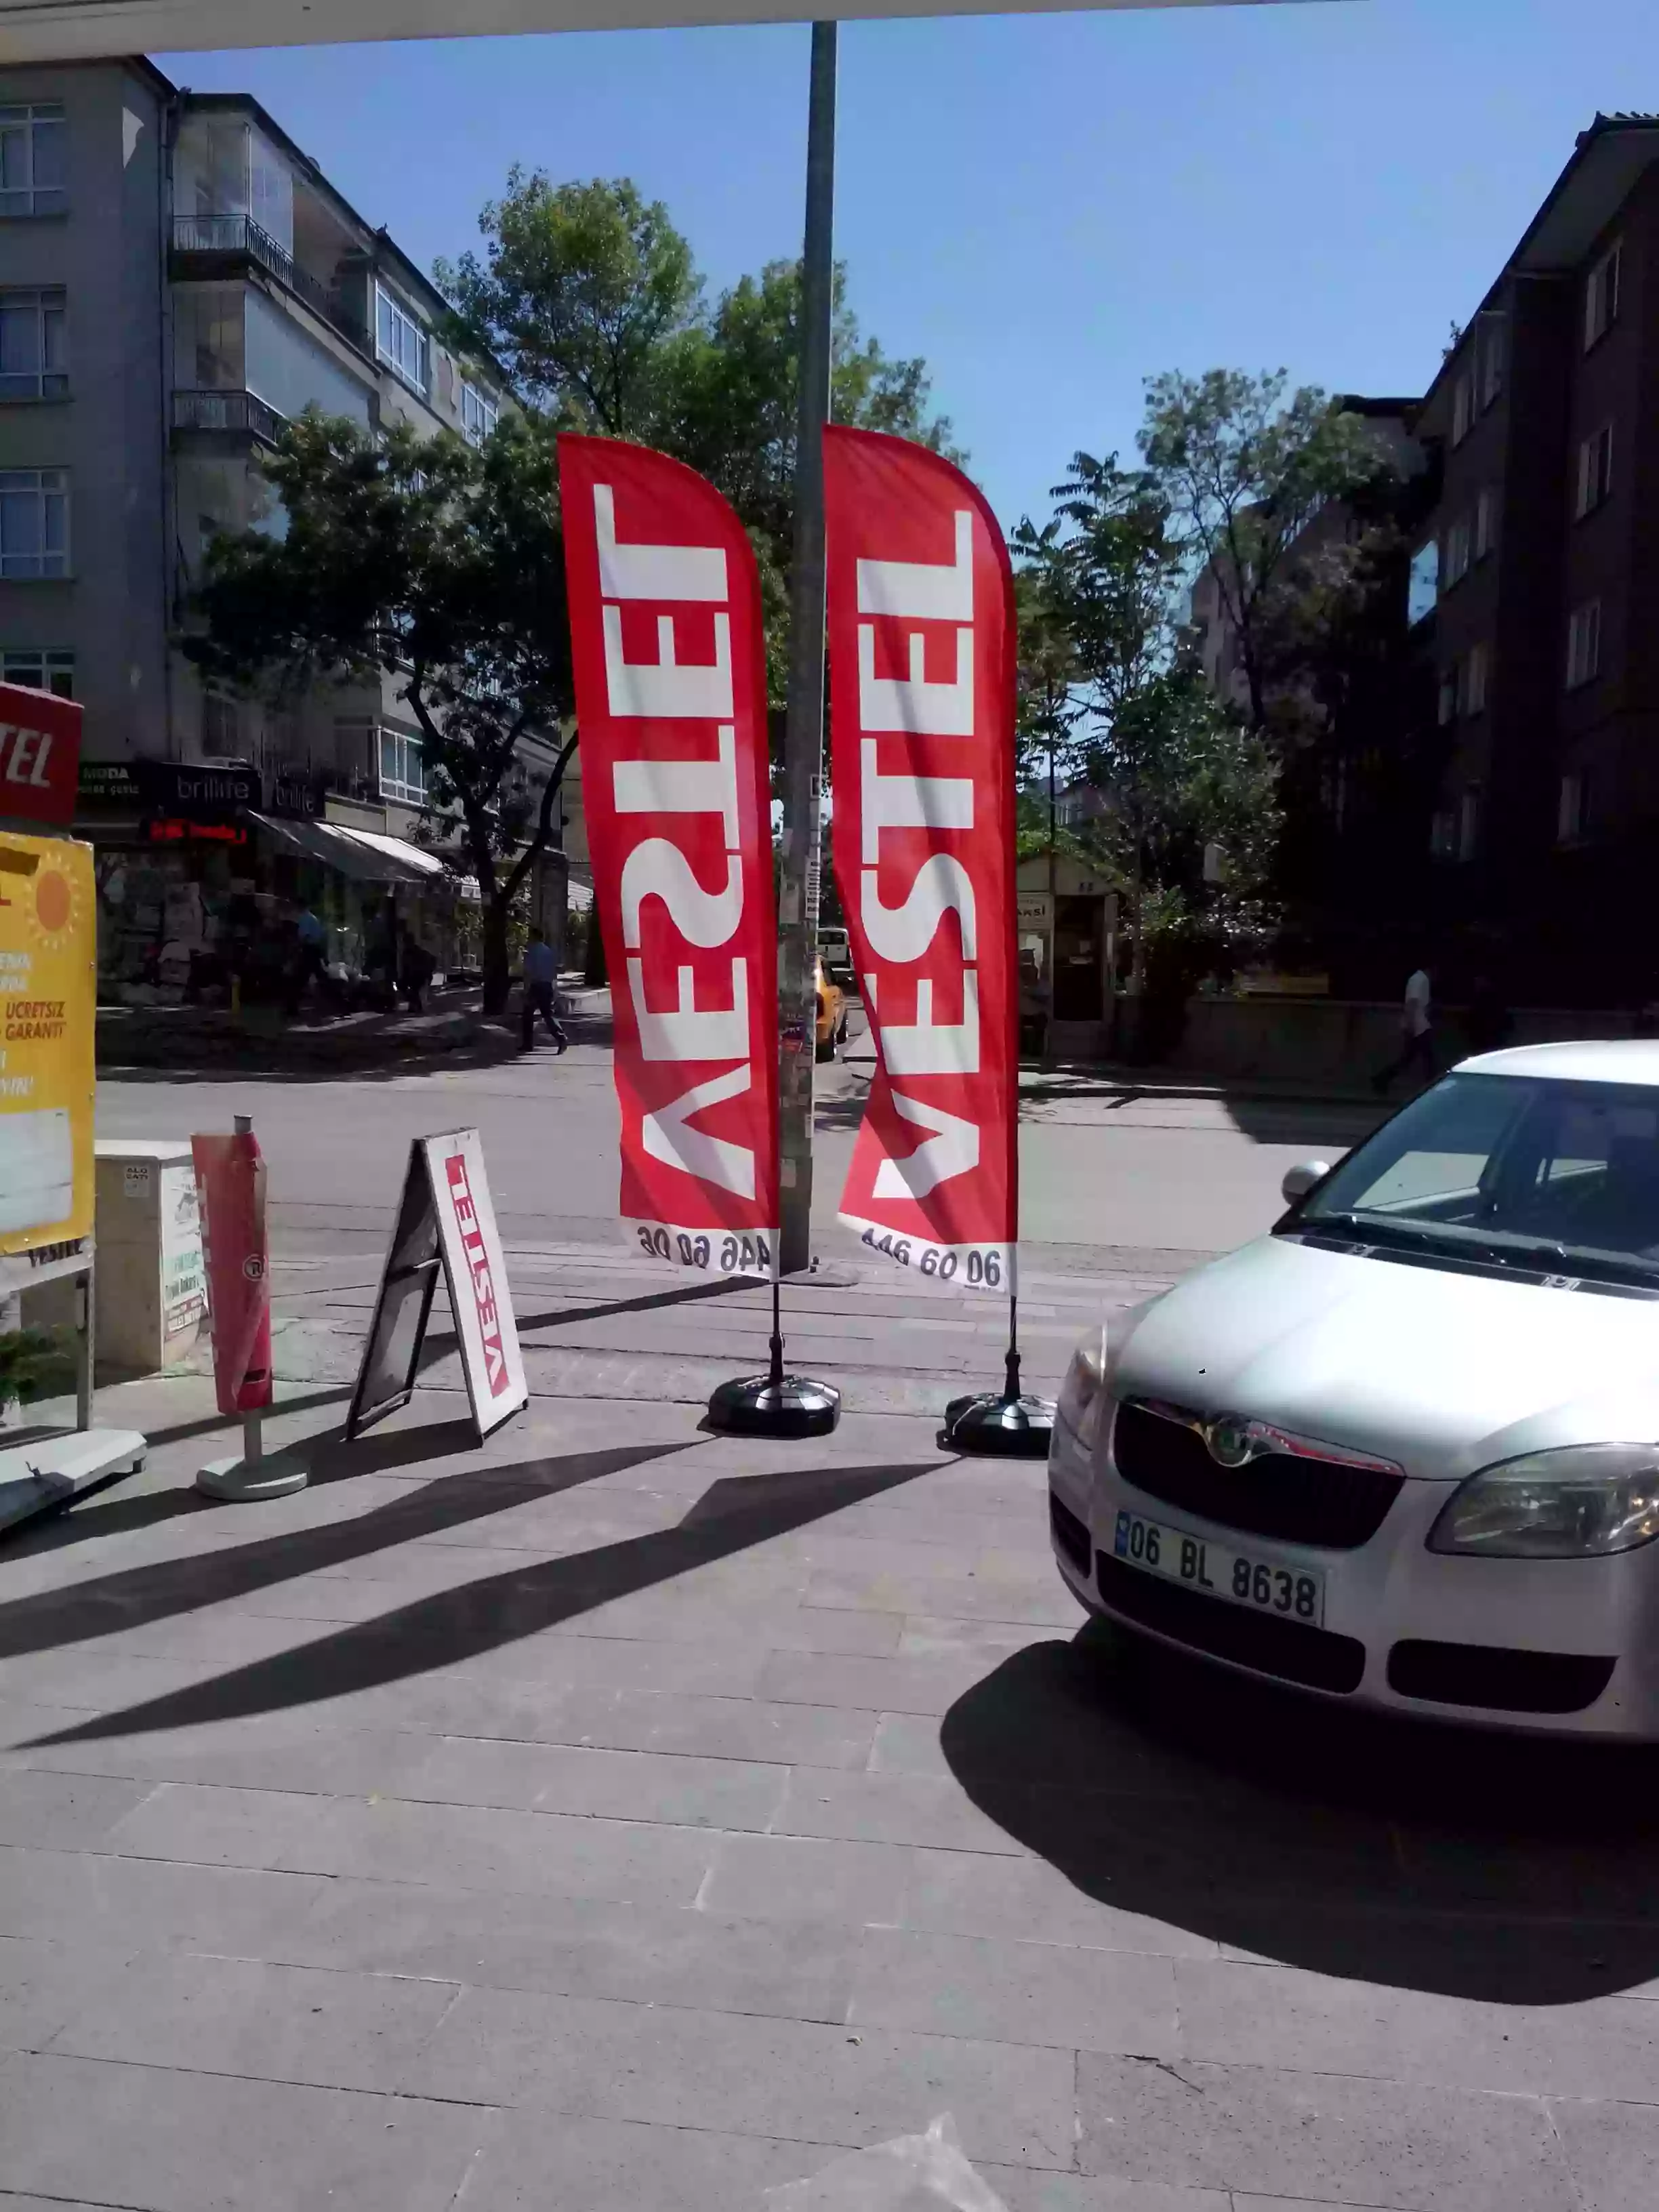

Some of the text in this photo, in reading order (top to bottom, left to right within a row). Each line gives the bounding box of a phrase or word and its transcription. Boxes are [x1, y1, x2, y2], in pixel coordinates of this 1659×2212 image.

[857, 510, 980, 1199] VESTEL
[449, 1163, 504, 1389] VESTEL
[920, 1248, 957, 1279] 60
[966, 1250, 1000, 1287] 06
[1130, 1521, 1316, 1618] 06 BL 8638
